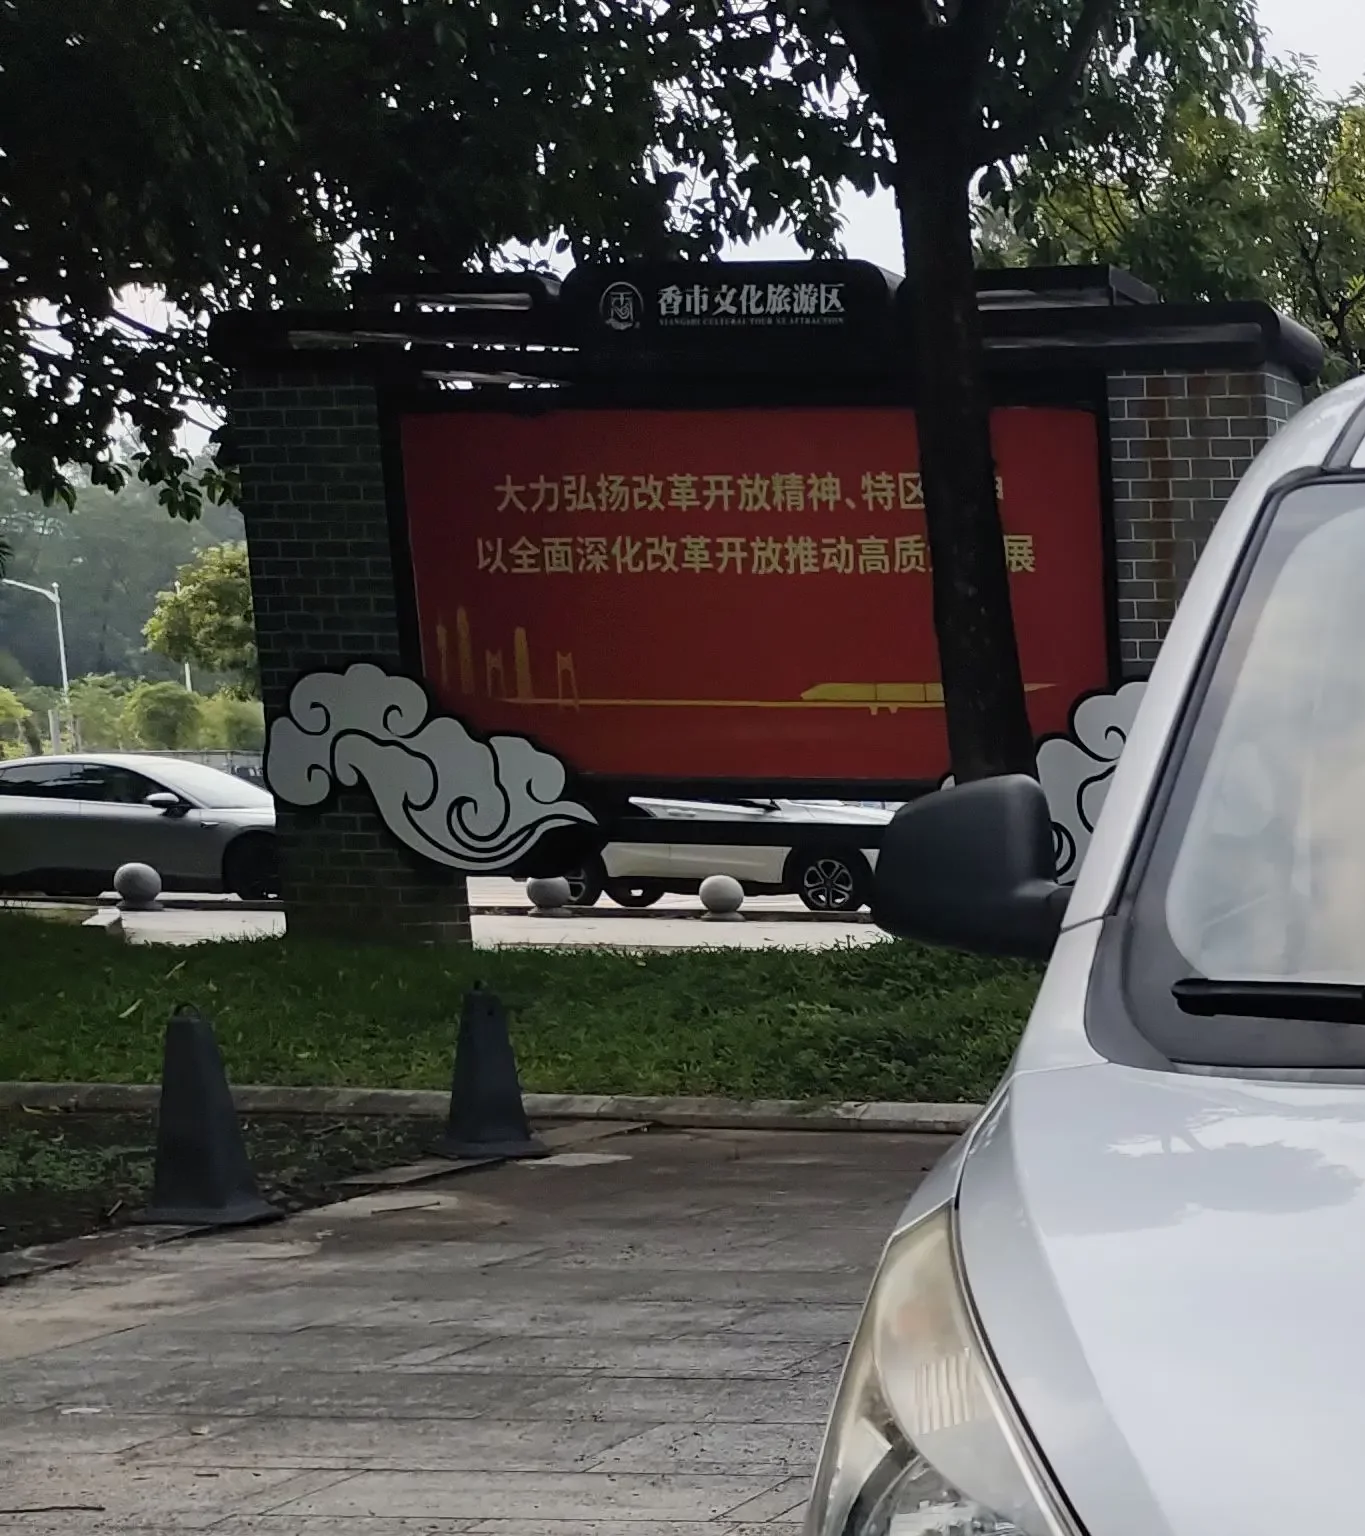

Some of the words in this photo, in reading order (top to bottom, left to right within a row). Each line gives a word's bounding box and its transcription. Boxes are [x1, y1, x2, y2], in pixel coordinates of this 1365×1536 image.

[657, 283, 846, 316] 香市文化旅游区
[494, 471, 1004, 513] 大力弘扬改革开放精神、特区
[476, 534, 1036, 575] 以全面深化改革开放推动高质展
